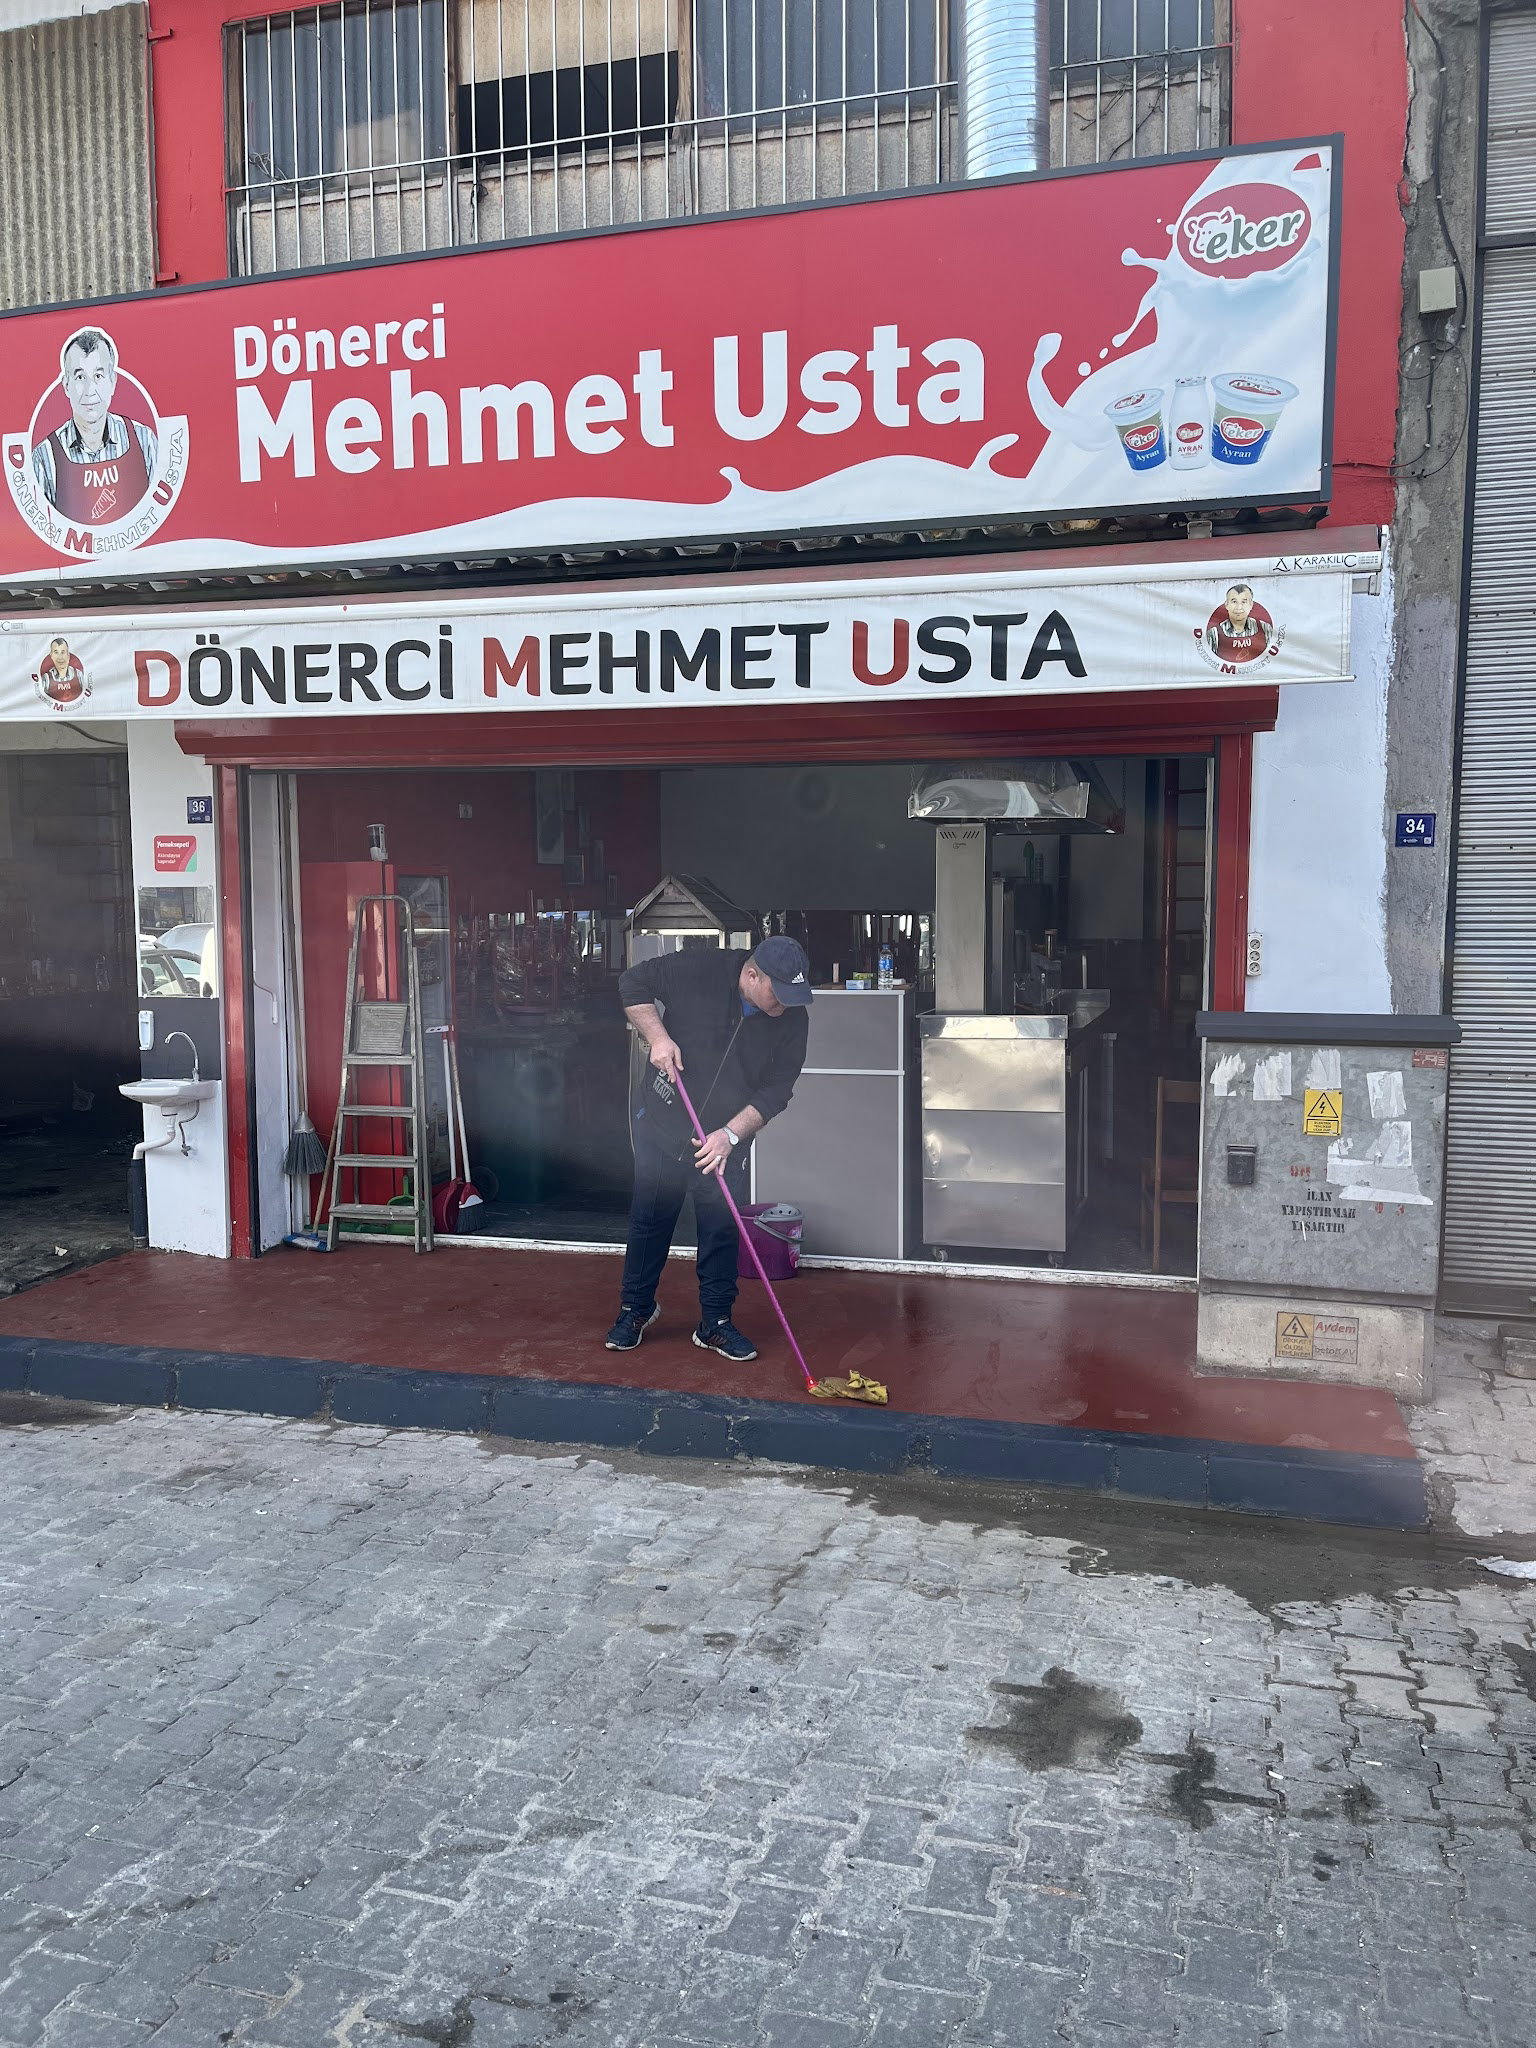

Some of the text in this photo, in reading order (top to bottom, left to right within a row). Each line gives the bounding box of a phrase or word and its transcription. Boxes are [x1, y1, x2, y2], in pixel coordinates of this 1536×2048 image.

[1206, 213, 1301, 259] eker
[233, 303, 446, 380] Dönerci
[236, 324, 985, 483] Mehmet Usta
[1133, 429, 1158, 447] eker
[1229, 425, 1259, 439] eker
[1135, 449, 1159, 462] Ayran
[1178, 444, 1203, 453] AYRAN
[1221, 446, 1251, 460] Ayran
[84, 465, 119, 488] DMU
[9, 428, 183, 553] DÖNERCİ MEHMET USTA
[1233, 639, 1252, 648] DMU
[134, 610, 1087, 707] DÖNERCİ MEHMET USTA
[192, 801, 206, 813] 36
[1405, 818, 1425, 834] 34
[1307, 1188, 1332, 1201] İLAN
[1282, 1205, 1356, 1219] YAPIŞTIRMAK
[1316, 1321, 1356, 1334] Aydem
